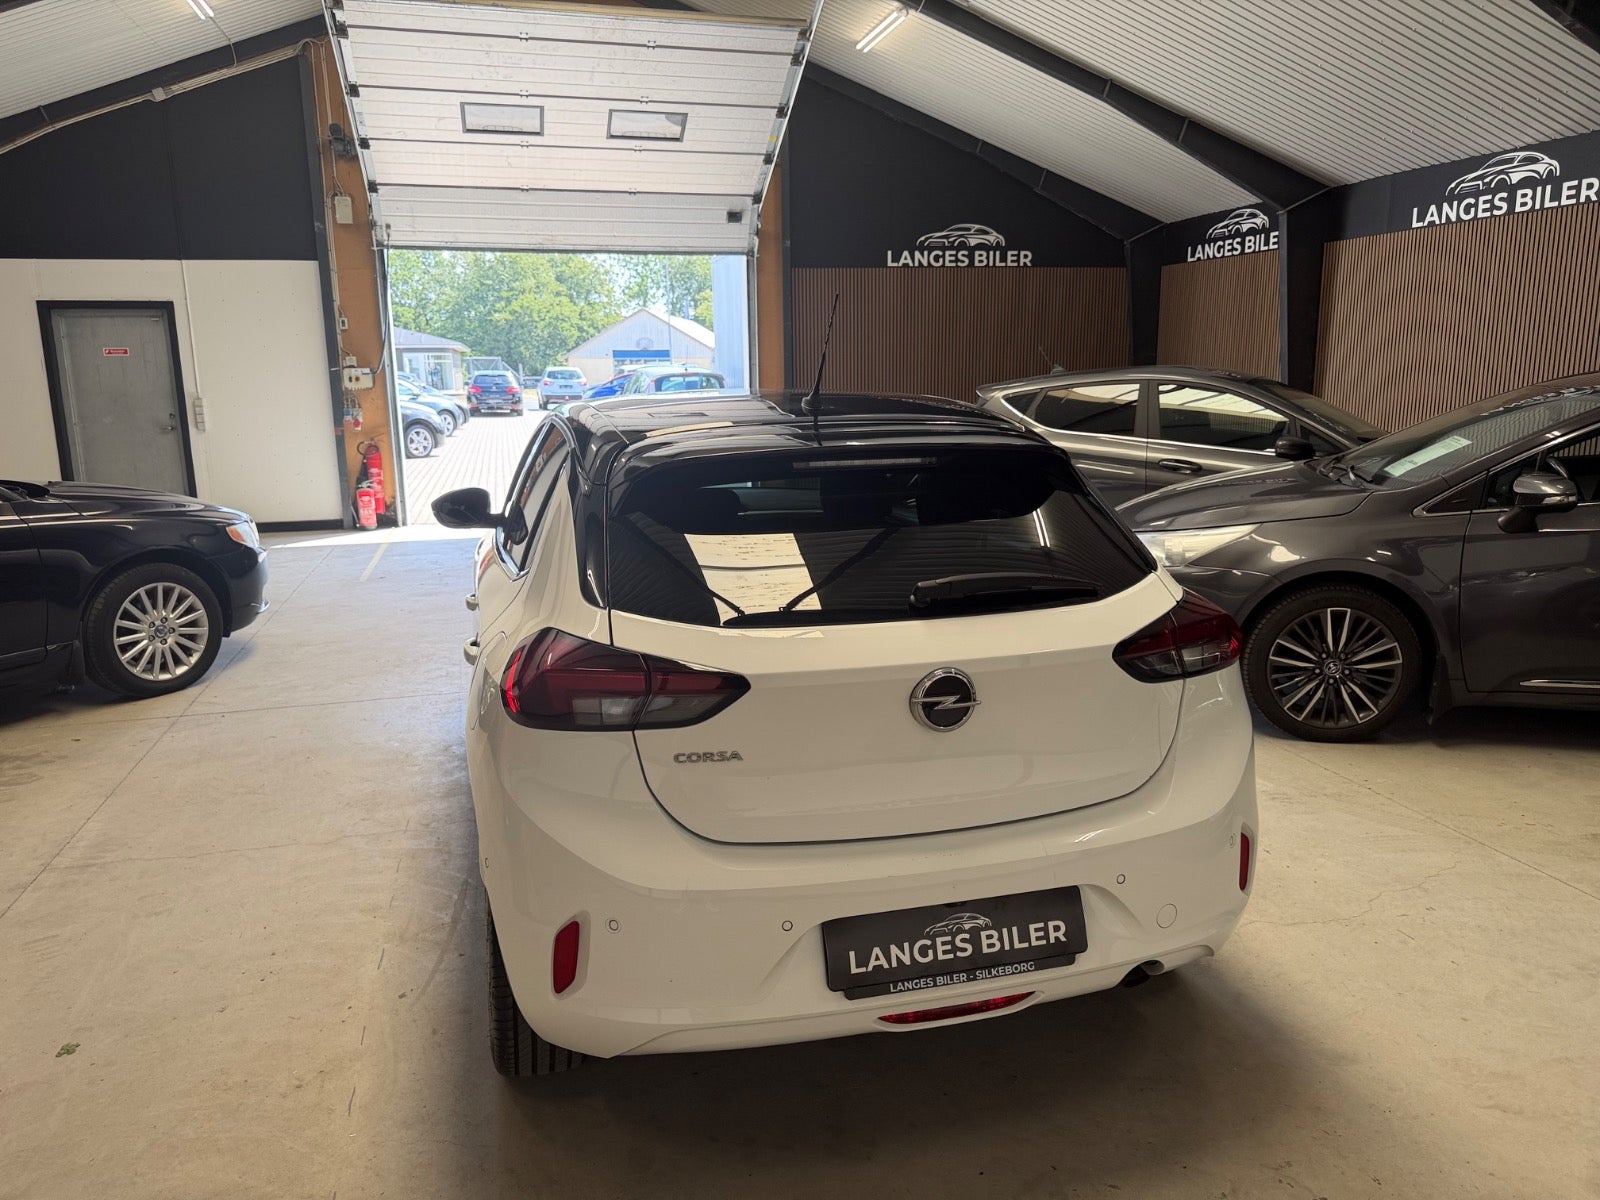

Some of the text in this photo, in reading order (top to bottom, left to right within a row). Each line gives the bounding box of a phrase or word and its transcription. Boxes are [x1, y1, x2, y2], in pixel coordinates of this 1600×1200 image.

[1411, 177, 1600, 228] LANGES BILER
[887, 250, 1032, 267] LANGES BILER
[1187, 231, 1279, 262] LANGES BILE
[673, 750, 744, 763] CORSA
[849, 920, 1067, 974] LANGES BILER
[890, 977, 934, 993] LANGES
[936, 973, 967, 986] BILER
[976, 961, 1035, 979] SILKEBORG
